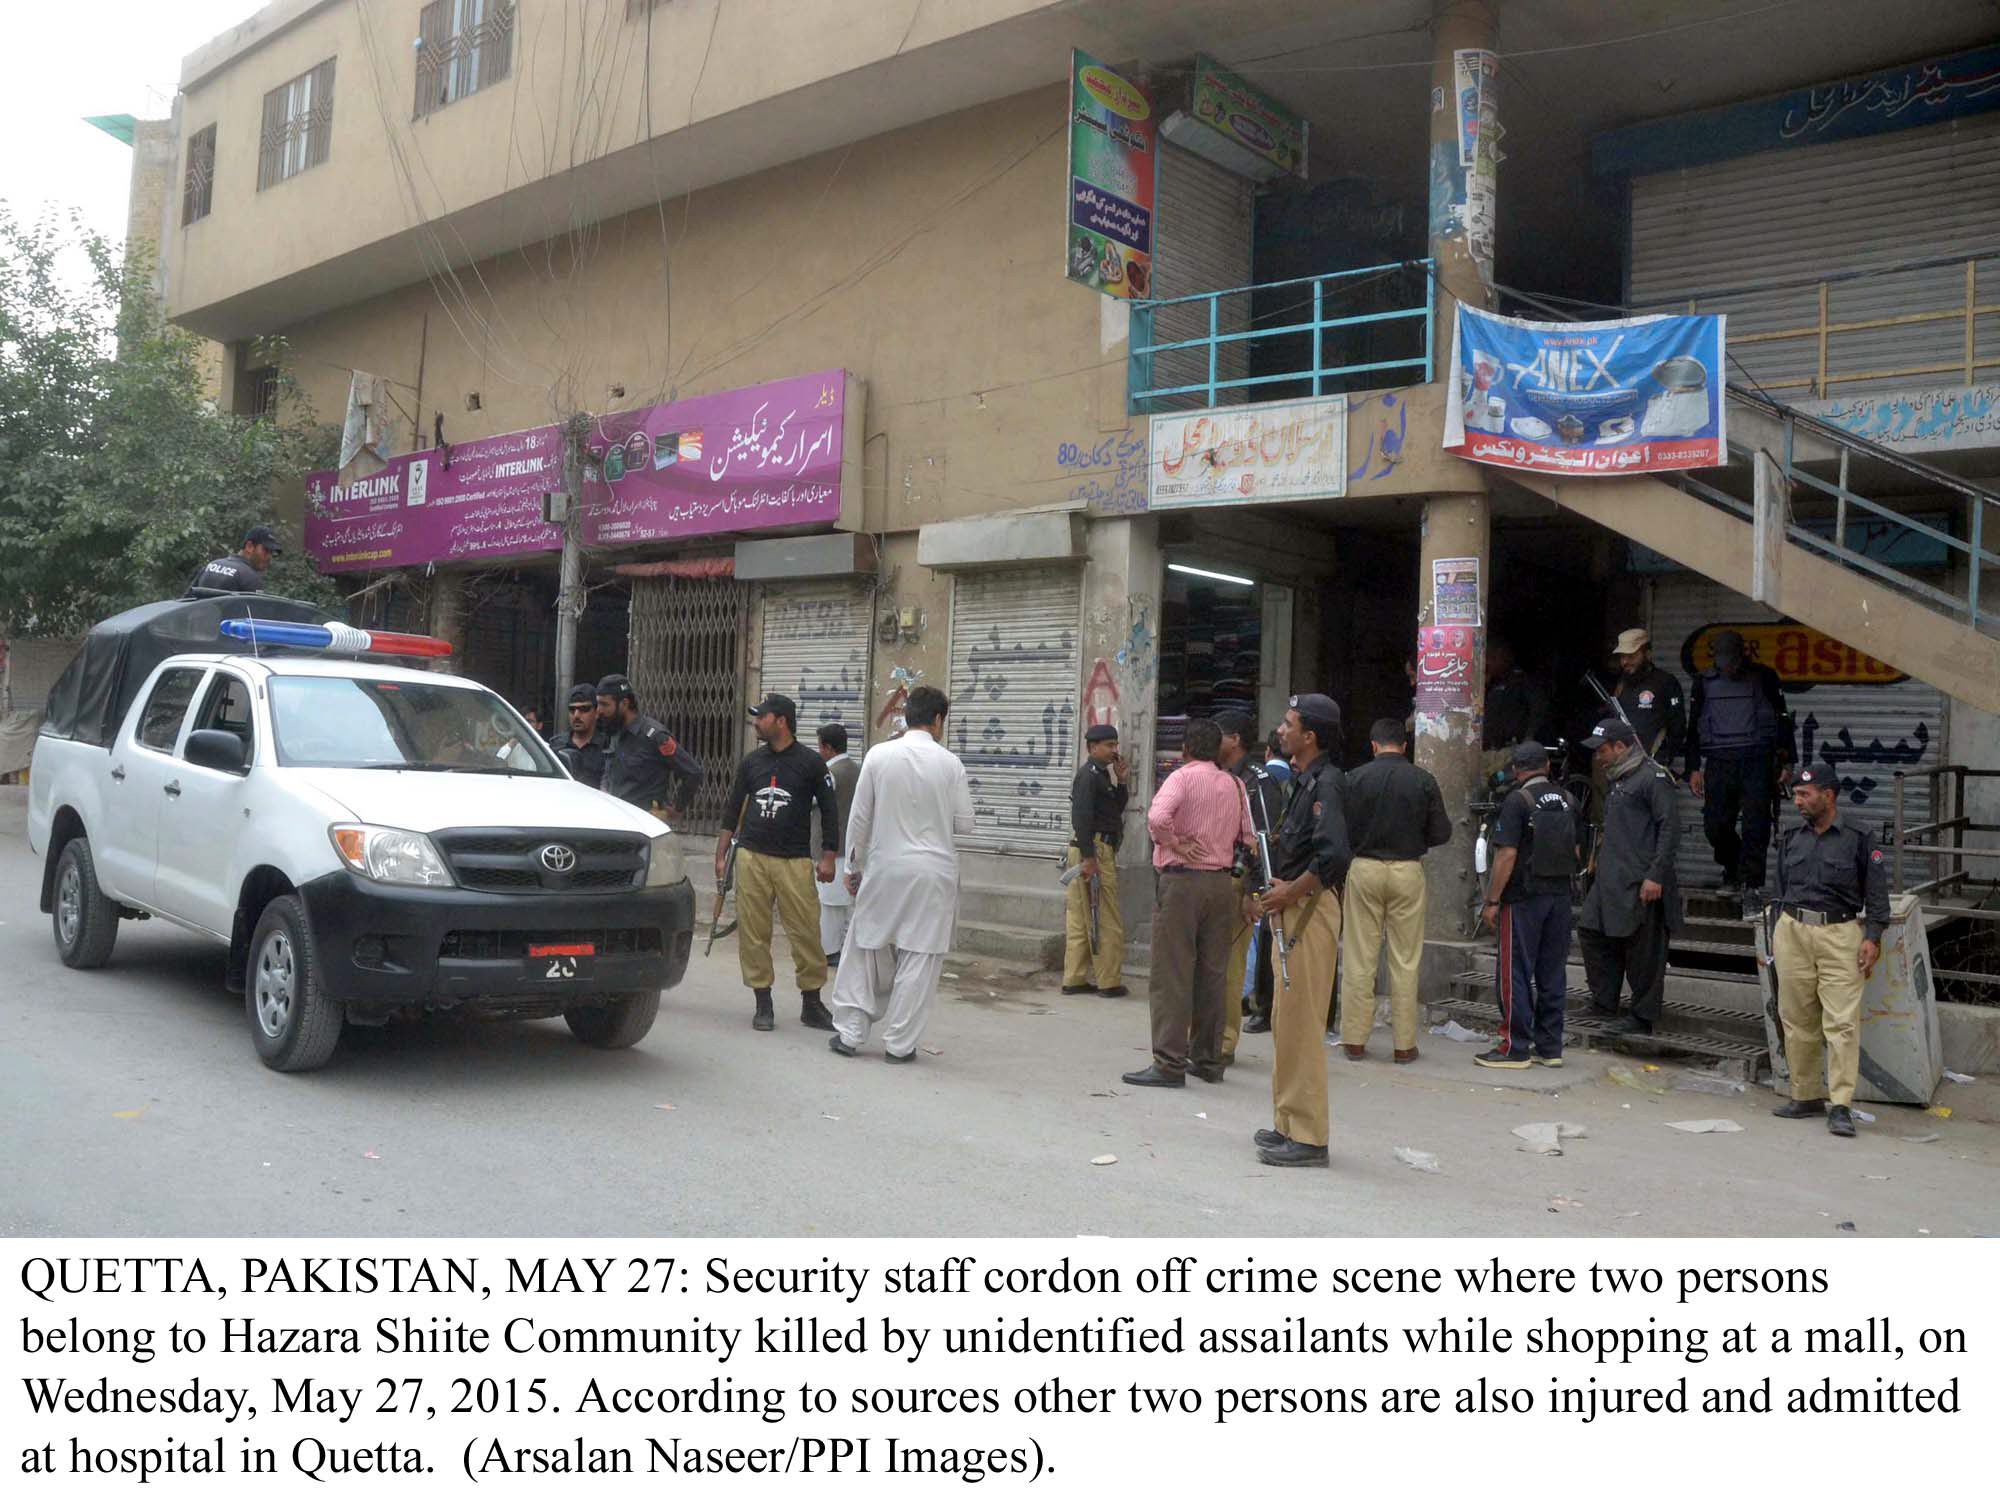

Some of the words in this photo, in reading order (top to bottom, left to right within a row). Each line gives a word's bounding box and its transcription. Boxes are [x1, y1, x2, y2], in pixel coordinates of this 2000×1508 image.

[1506, 334, 1625, 393] ANEX
[495, 457, 544, 478] INTERLINK
[205, 562, 238, 577] POLICE
